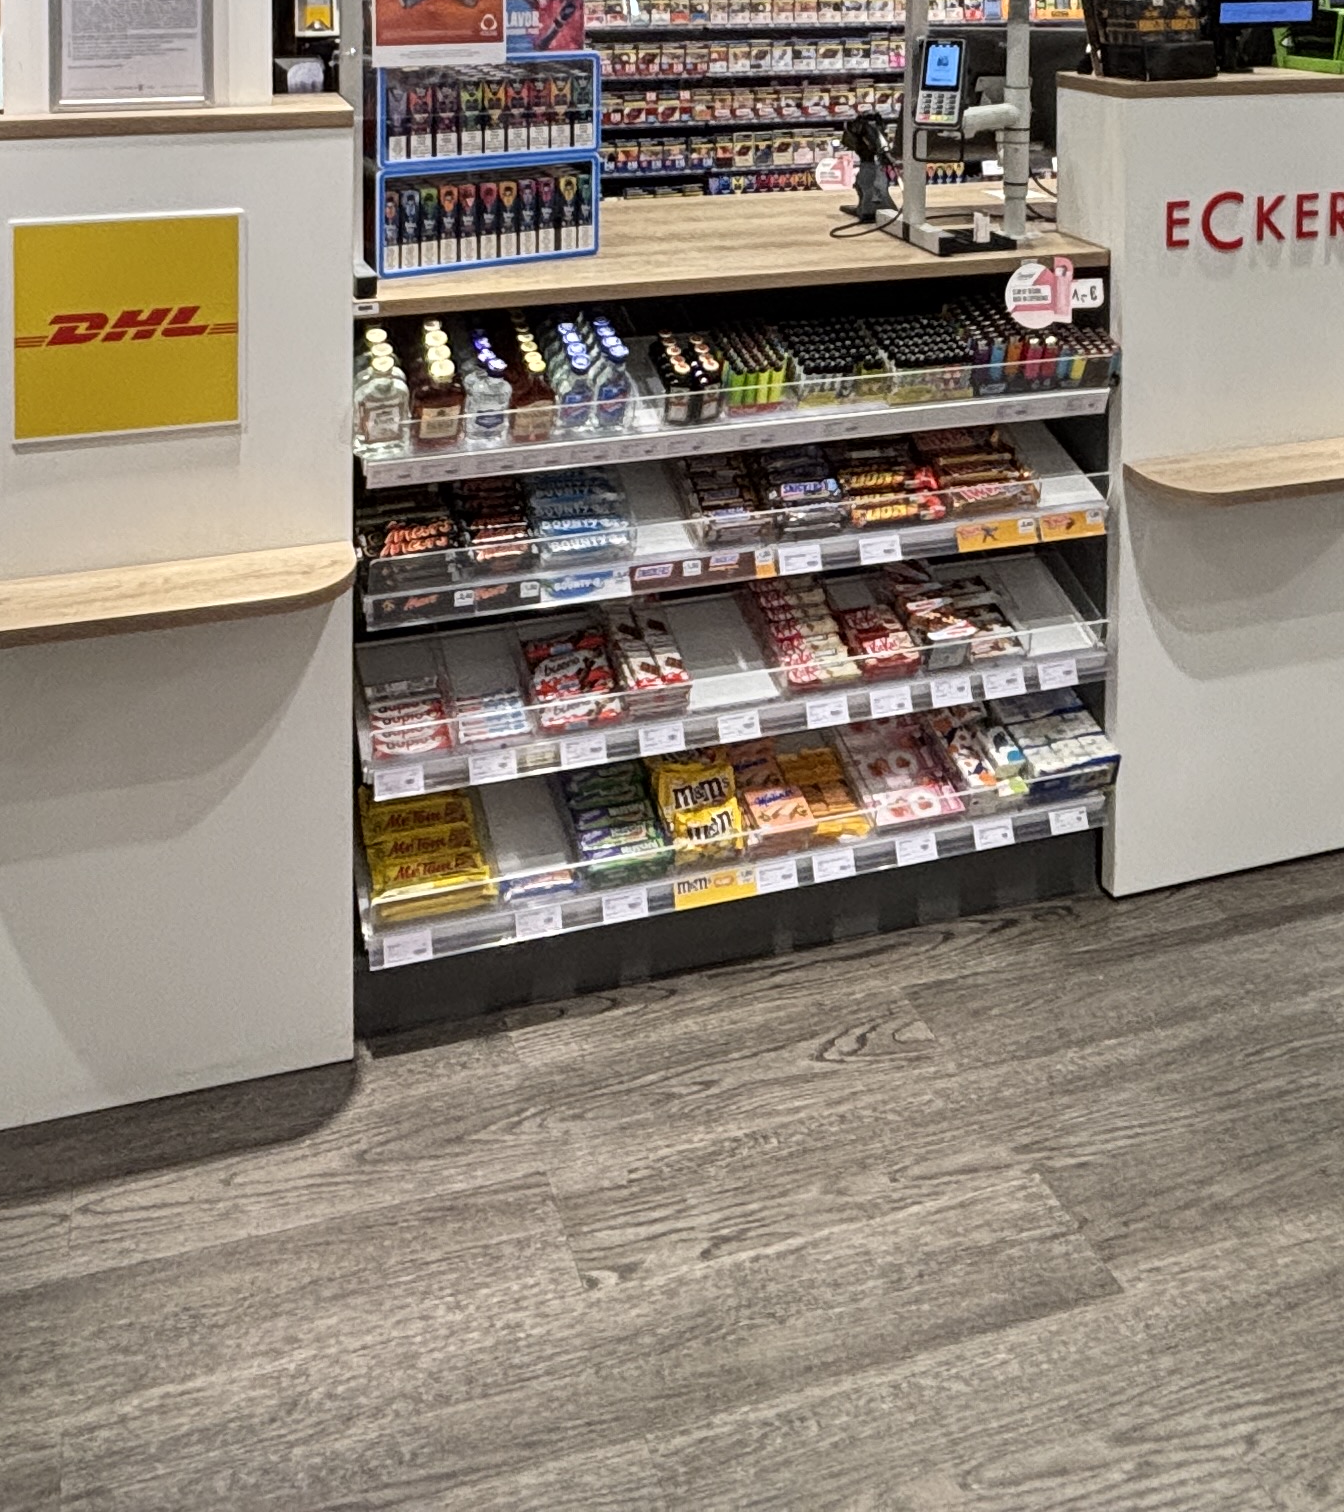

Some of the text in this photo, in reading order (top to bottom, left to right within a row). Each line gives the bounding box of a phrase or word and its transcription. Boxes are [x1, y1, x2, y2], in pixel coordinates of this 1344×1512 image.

[46, 306, 209, 347] DHL
[544, 656, 580, 676] bueno
[386, 736, 428, 750] duplo
